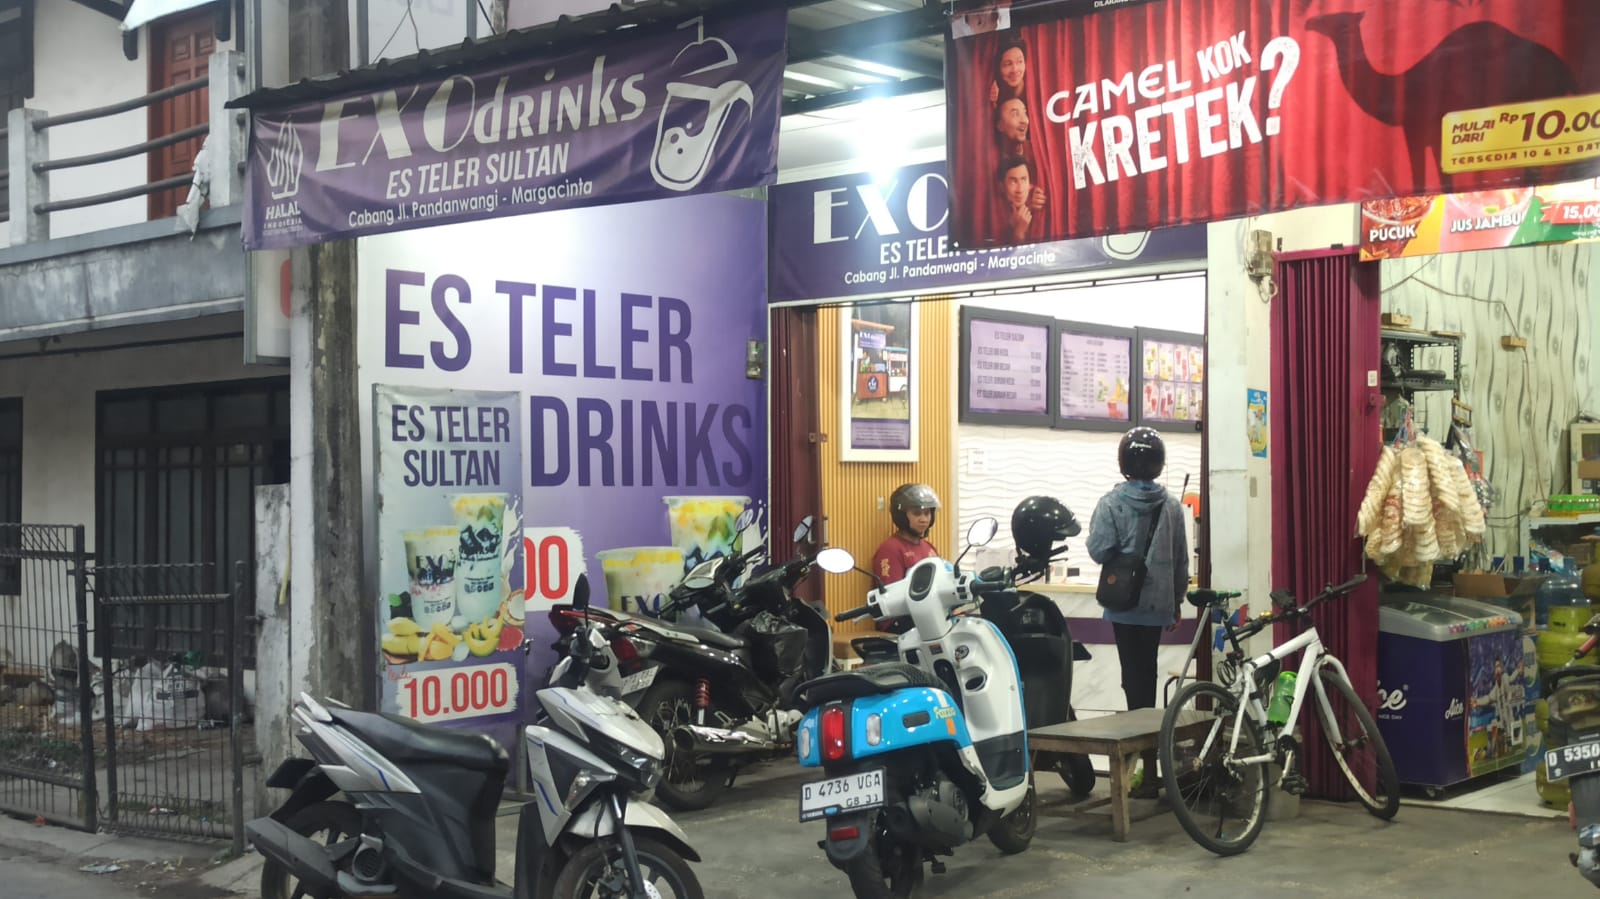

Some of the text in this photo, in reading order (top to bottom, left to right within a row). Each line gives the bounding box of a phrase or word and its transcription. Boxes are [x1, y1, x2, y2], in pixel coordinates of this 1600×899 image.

[1046, 30, 1252, 123] CAMEL KOK
[1452, 119, 1495, 134] MULAI
[1500, 112, 1519, 124] Rp
[1452, 132, 1485, 145] DARI
[386, 142, 570, 200] ES TELER SULTAN
[1451, 151, 1518, 166] TERSEDIA
[1523, 149, 1538, 159] 10
[1543, 148, 1552, 157] &
[1558, 146, 1571, 155] 12
[265, 201, 301, 220] HALAL
[349, 208, 394, 227] Cabang
[412, 189, 498, 217] Pandanwangi
[512, 177, 593, 205] Margacinta
[1369, 224, 1416, 243] PUCUK
[1450, 210, 1522, 233] JUS JAMBU
[880, 241, 902, 265] ES
[906, 235, 961, 262] TELE
[844, 271, 887, 284] Cabang
[903, 257, 978, 278] Pandanwangi
[988, 249, 1056, 270] Margacinta
[385, 268, 693, 384] ES TELER
[392, 404, 510, 443] ES TELER
[530, 395, 753, 488] DRINKS
[403, 449, 500, 487] SULTAN
[404, 668, 508, 718] 10.000
[804, 773, 881, 800] D 4736 VGA
